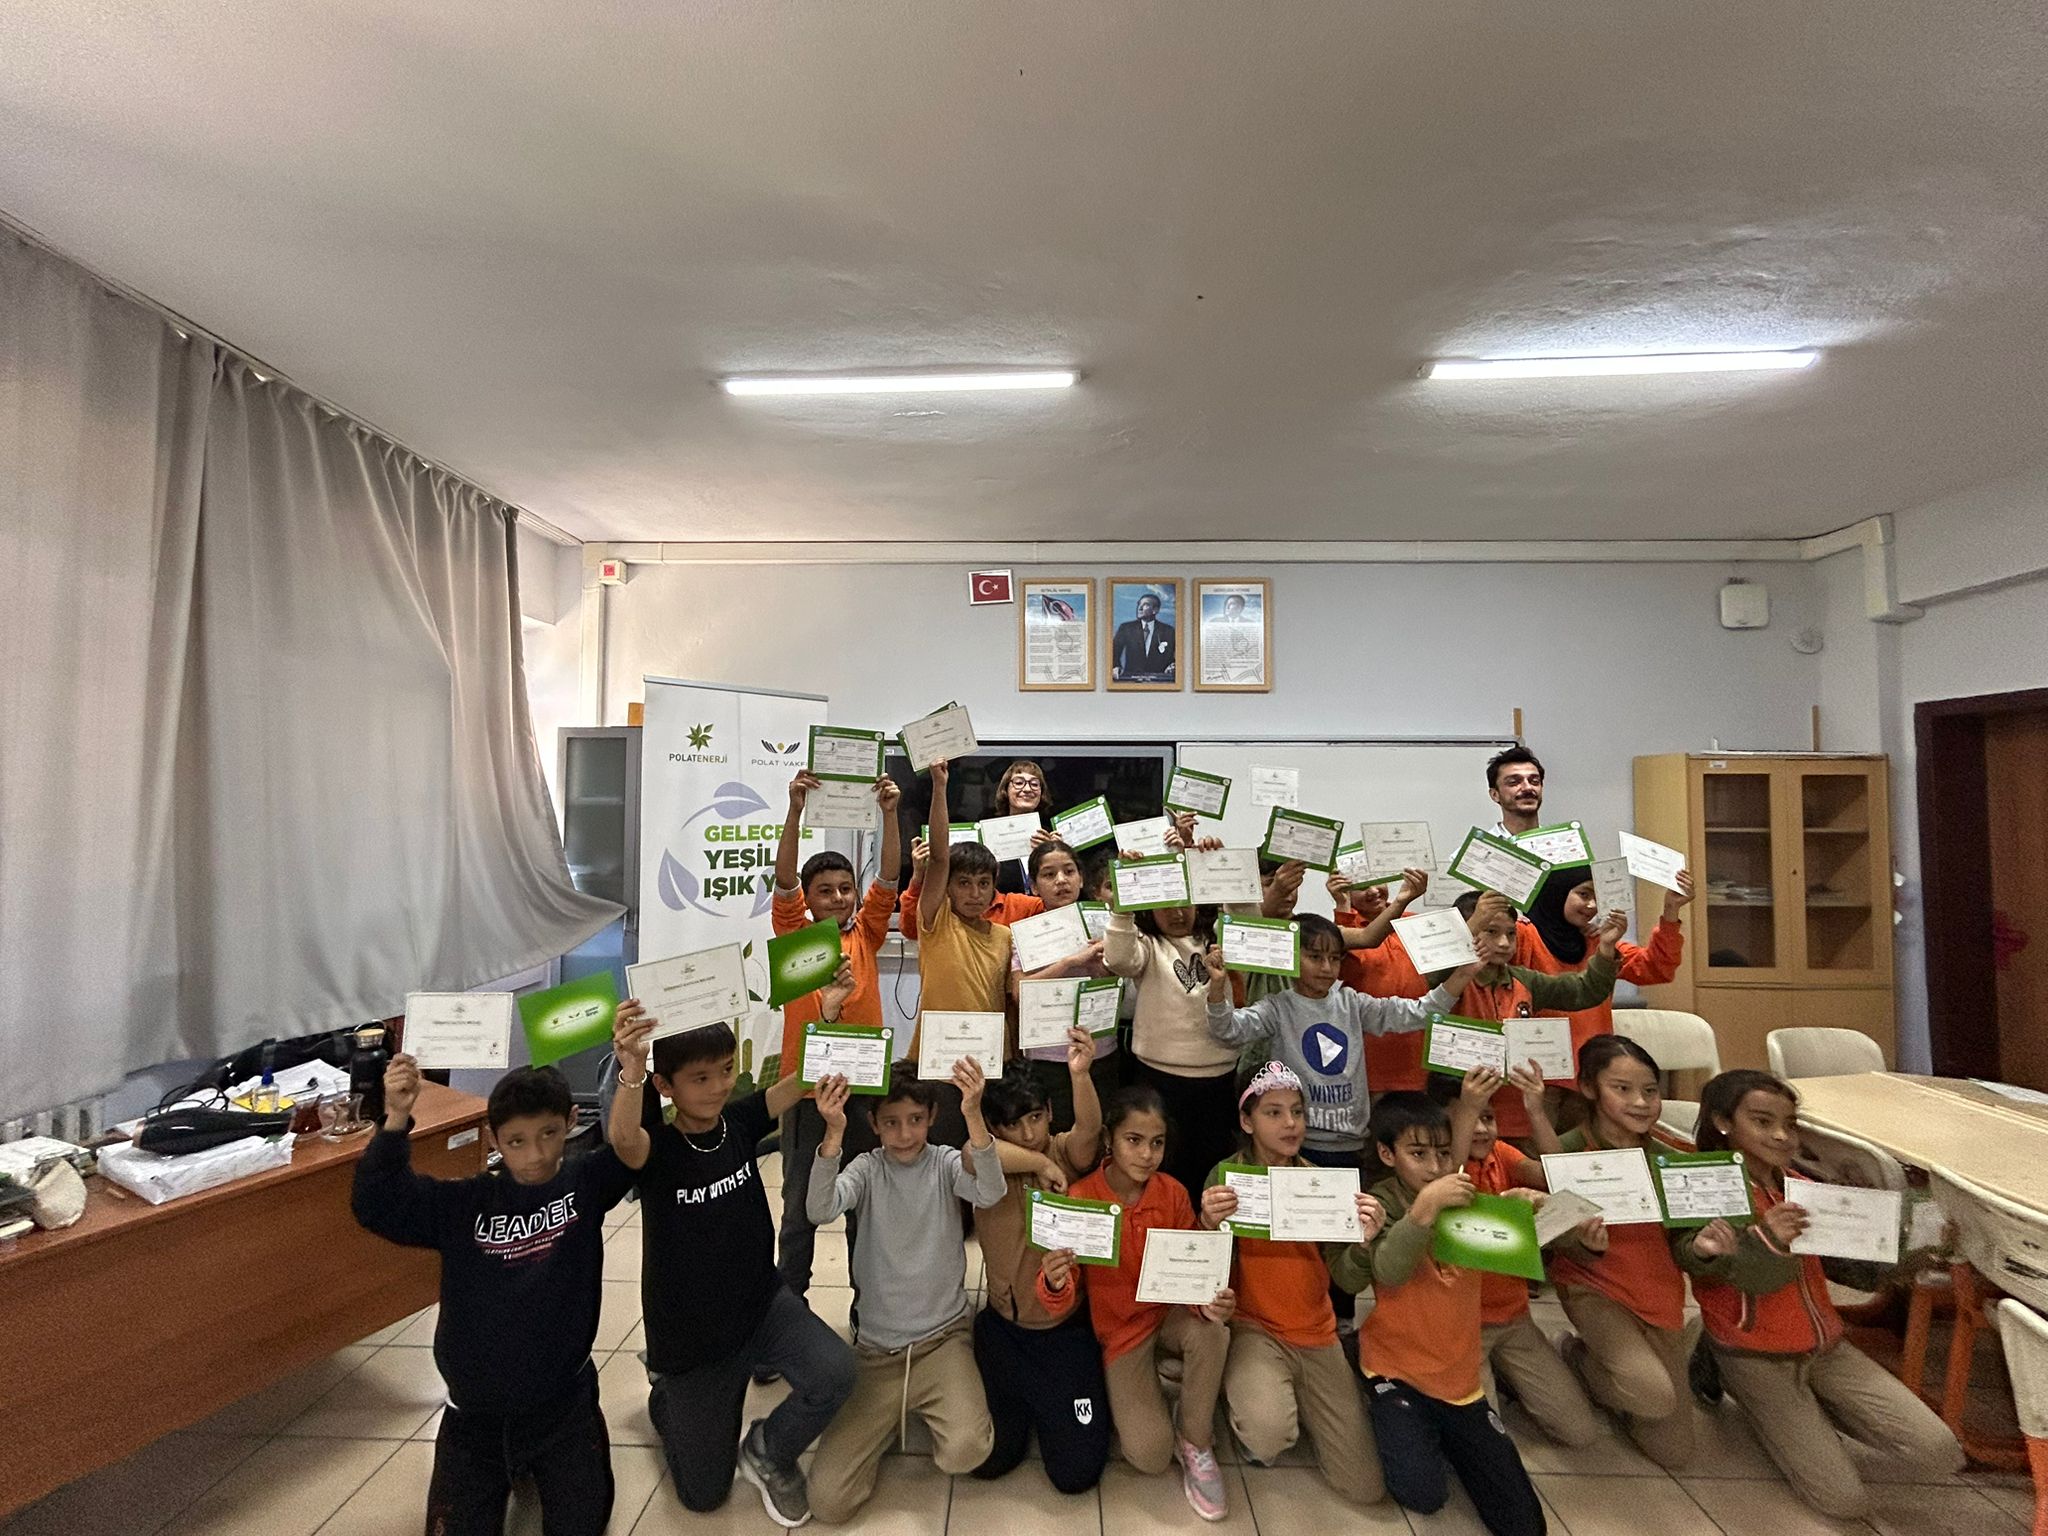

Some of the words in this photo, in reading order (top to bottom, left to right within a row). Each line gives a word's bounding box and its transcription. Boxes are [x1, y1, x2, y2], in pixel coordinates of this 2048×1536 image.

[704, 825, 813, 842] GELECEE
[704, 843, 776, 871] YEŞİL
[704, 875, 755, 901] IŞIK
[1308, 1083, 1353, 1104] WINTER
[1309, 1106, 1355, 1132] MODE
[677, 1186, 708, 1204] PLAY
[708, 1174, 737, 1199] WITH
[1076, 1403, 1091, 1417] KK
